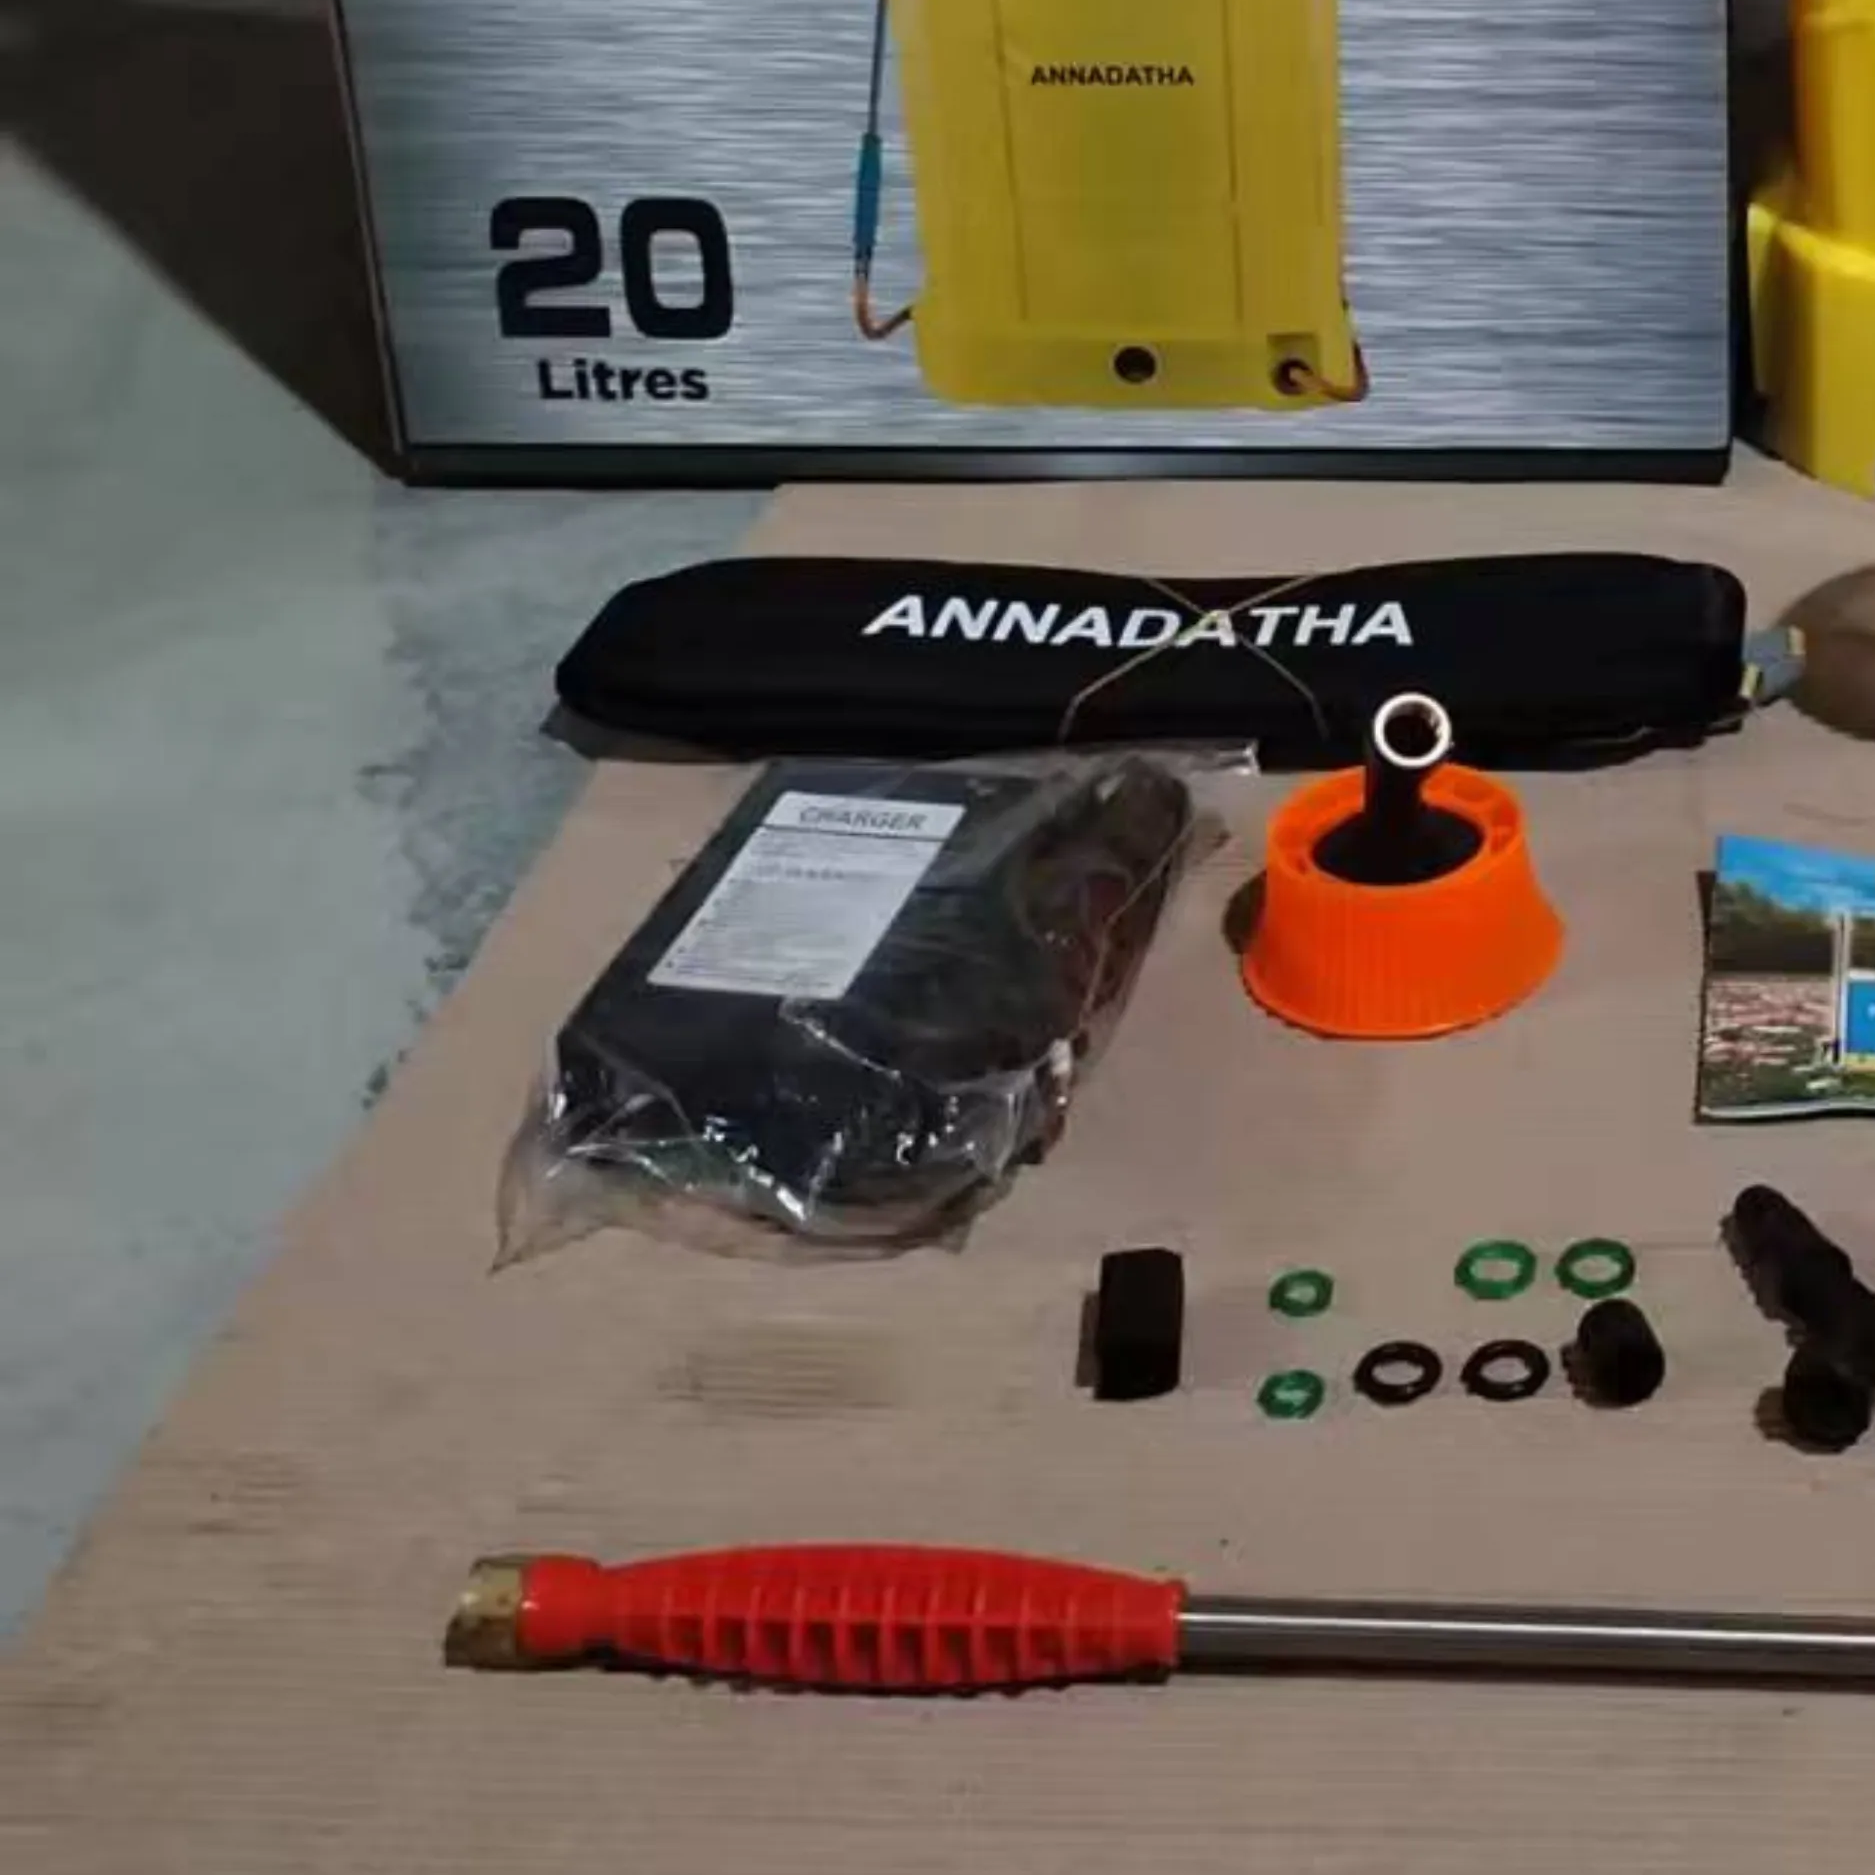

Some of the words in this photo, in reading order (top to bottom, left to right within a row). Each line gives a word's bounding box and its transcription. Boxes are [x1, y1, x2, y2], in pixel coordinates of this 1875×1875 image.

[1029, 63, 1196, 88] ANNADATHA
[488, 195, 736, 341] 20
[534, 356, 710, 403] Litres
[861, 594, 1415, 649] ANNADATHA
[799, 805, 929, 832] CHARGER
